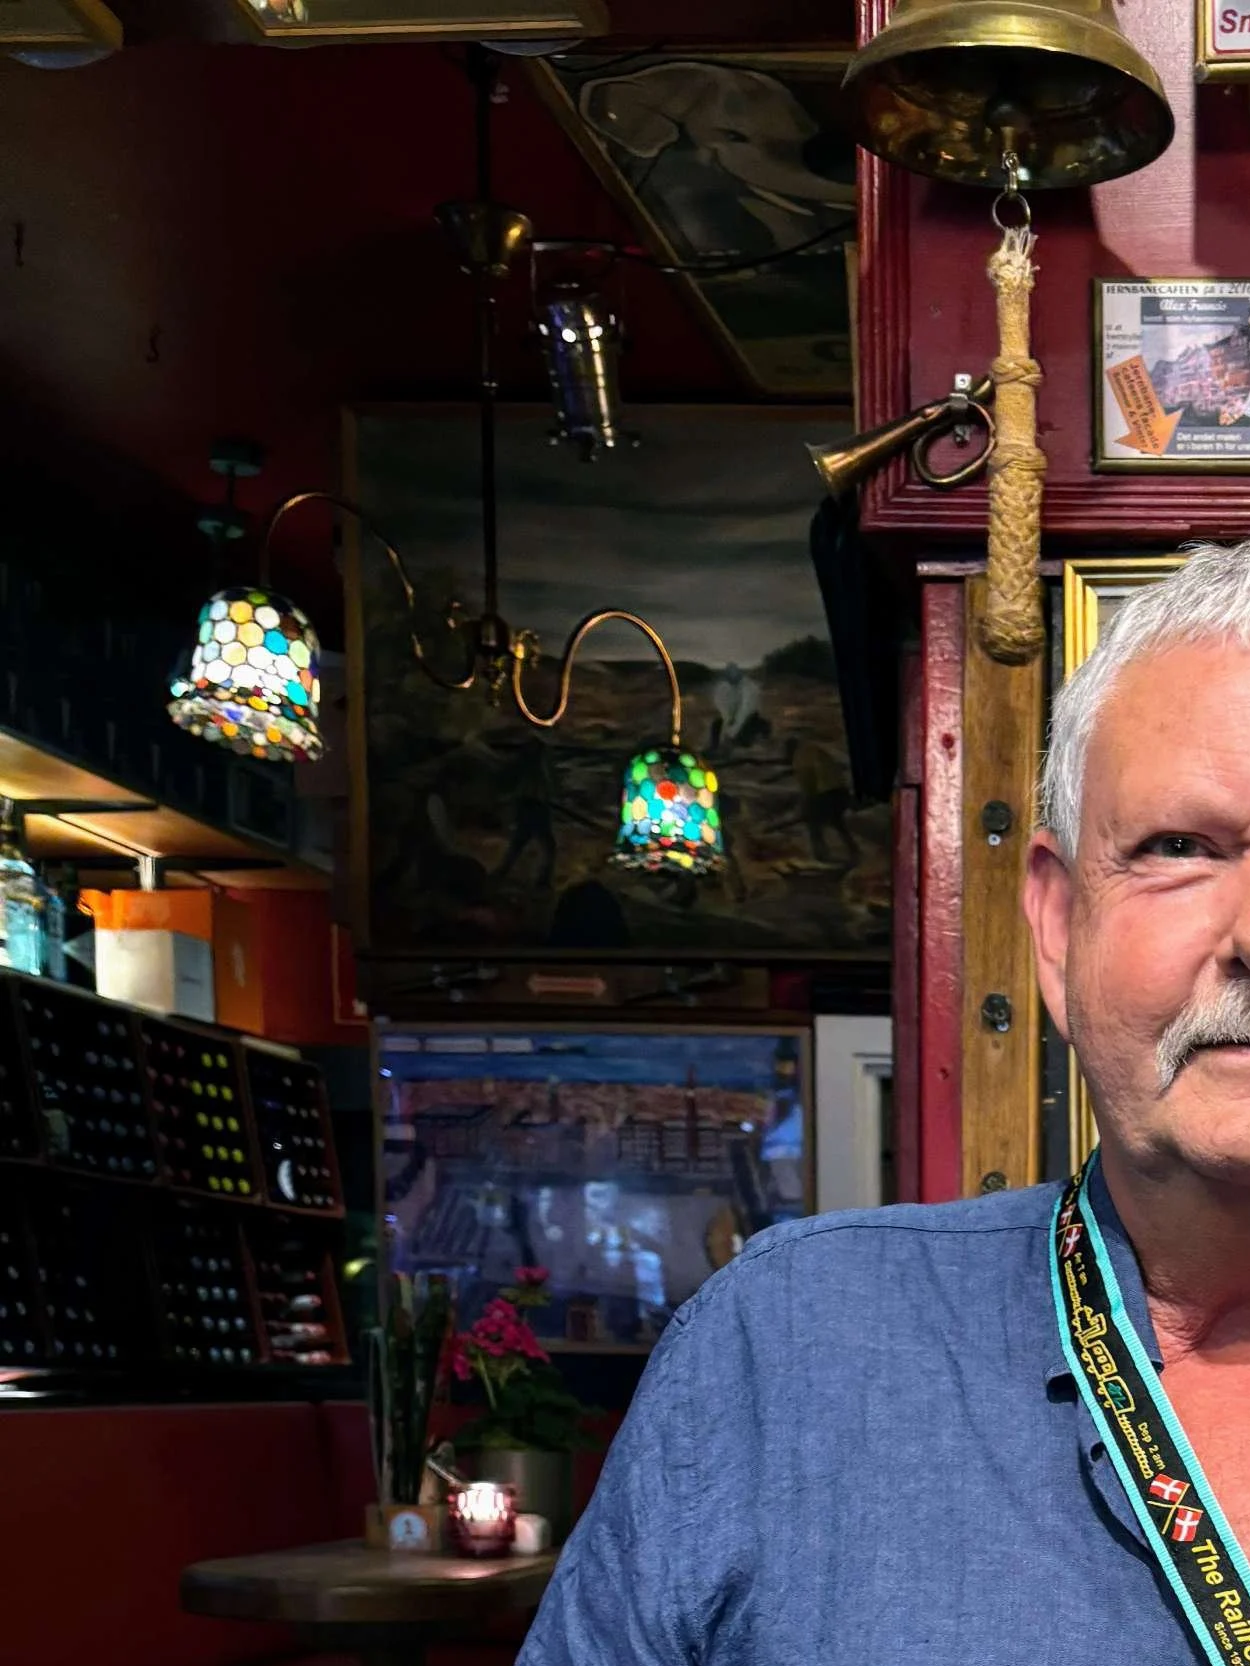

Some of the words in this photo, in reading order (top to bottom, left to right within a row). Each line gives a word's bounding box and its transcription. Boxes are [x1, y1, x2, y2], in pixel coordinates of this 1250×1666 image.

[1138, 1422, 1153, 1443] Dep
[1148, 1444, 1159, 1454] 2
[1152, 1453, 1166, 1470] am
[1191, 1538, 1224, 1586] The
[1214, 1621, 1233, 1651] Since
